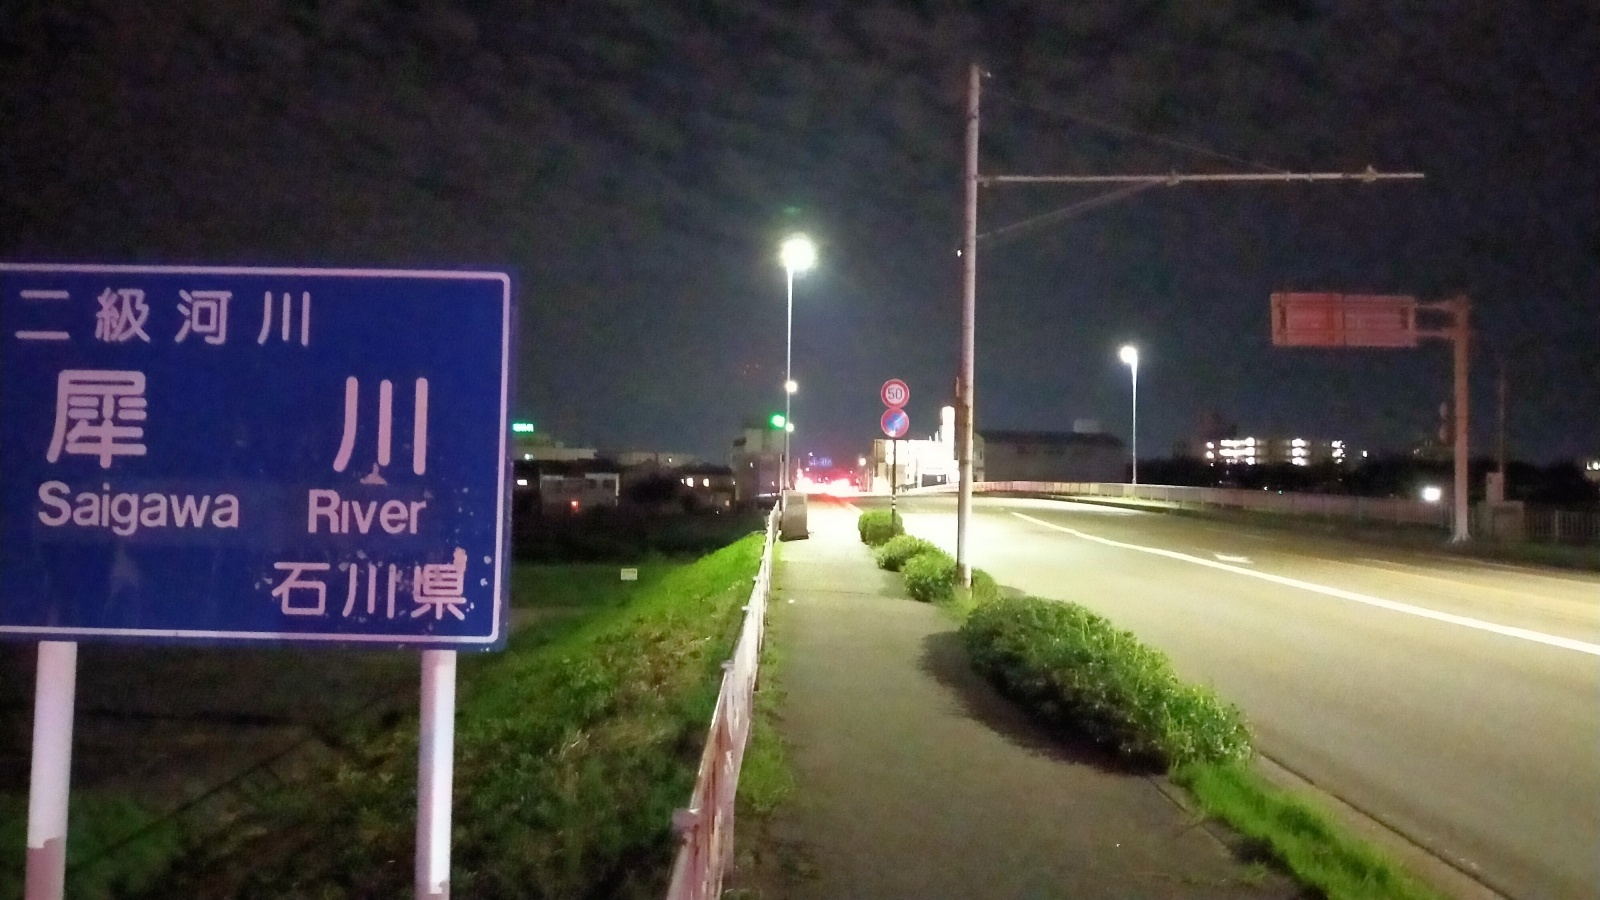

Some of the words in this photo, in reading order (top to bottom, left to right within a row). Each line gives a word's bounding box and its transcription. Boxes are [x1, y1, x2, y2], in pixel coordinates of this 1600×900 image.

[15, 287, 311, 347] 二級河川
[888, 388, 903, 400] 50
[37, 481, 240, 536] Saigawa
[307, 488, 427, 534] River
[271, 561, 467, 621] 石川県
